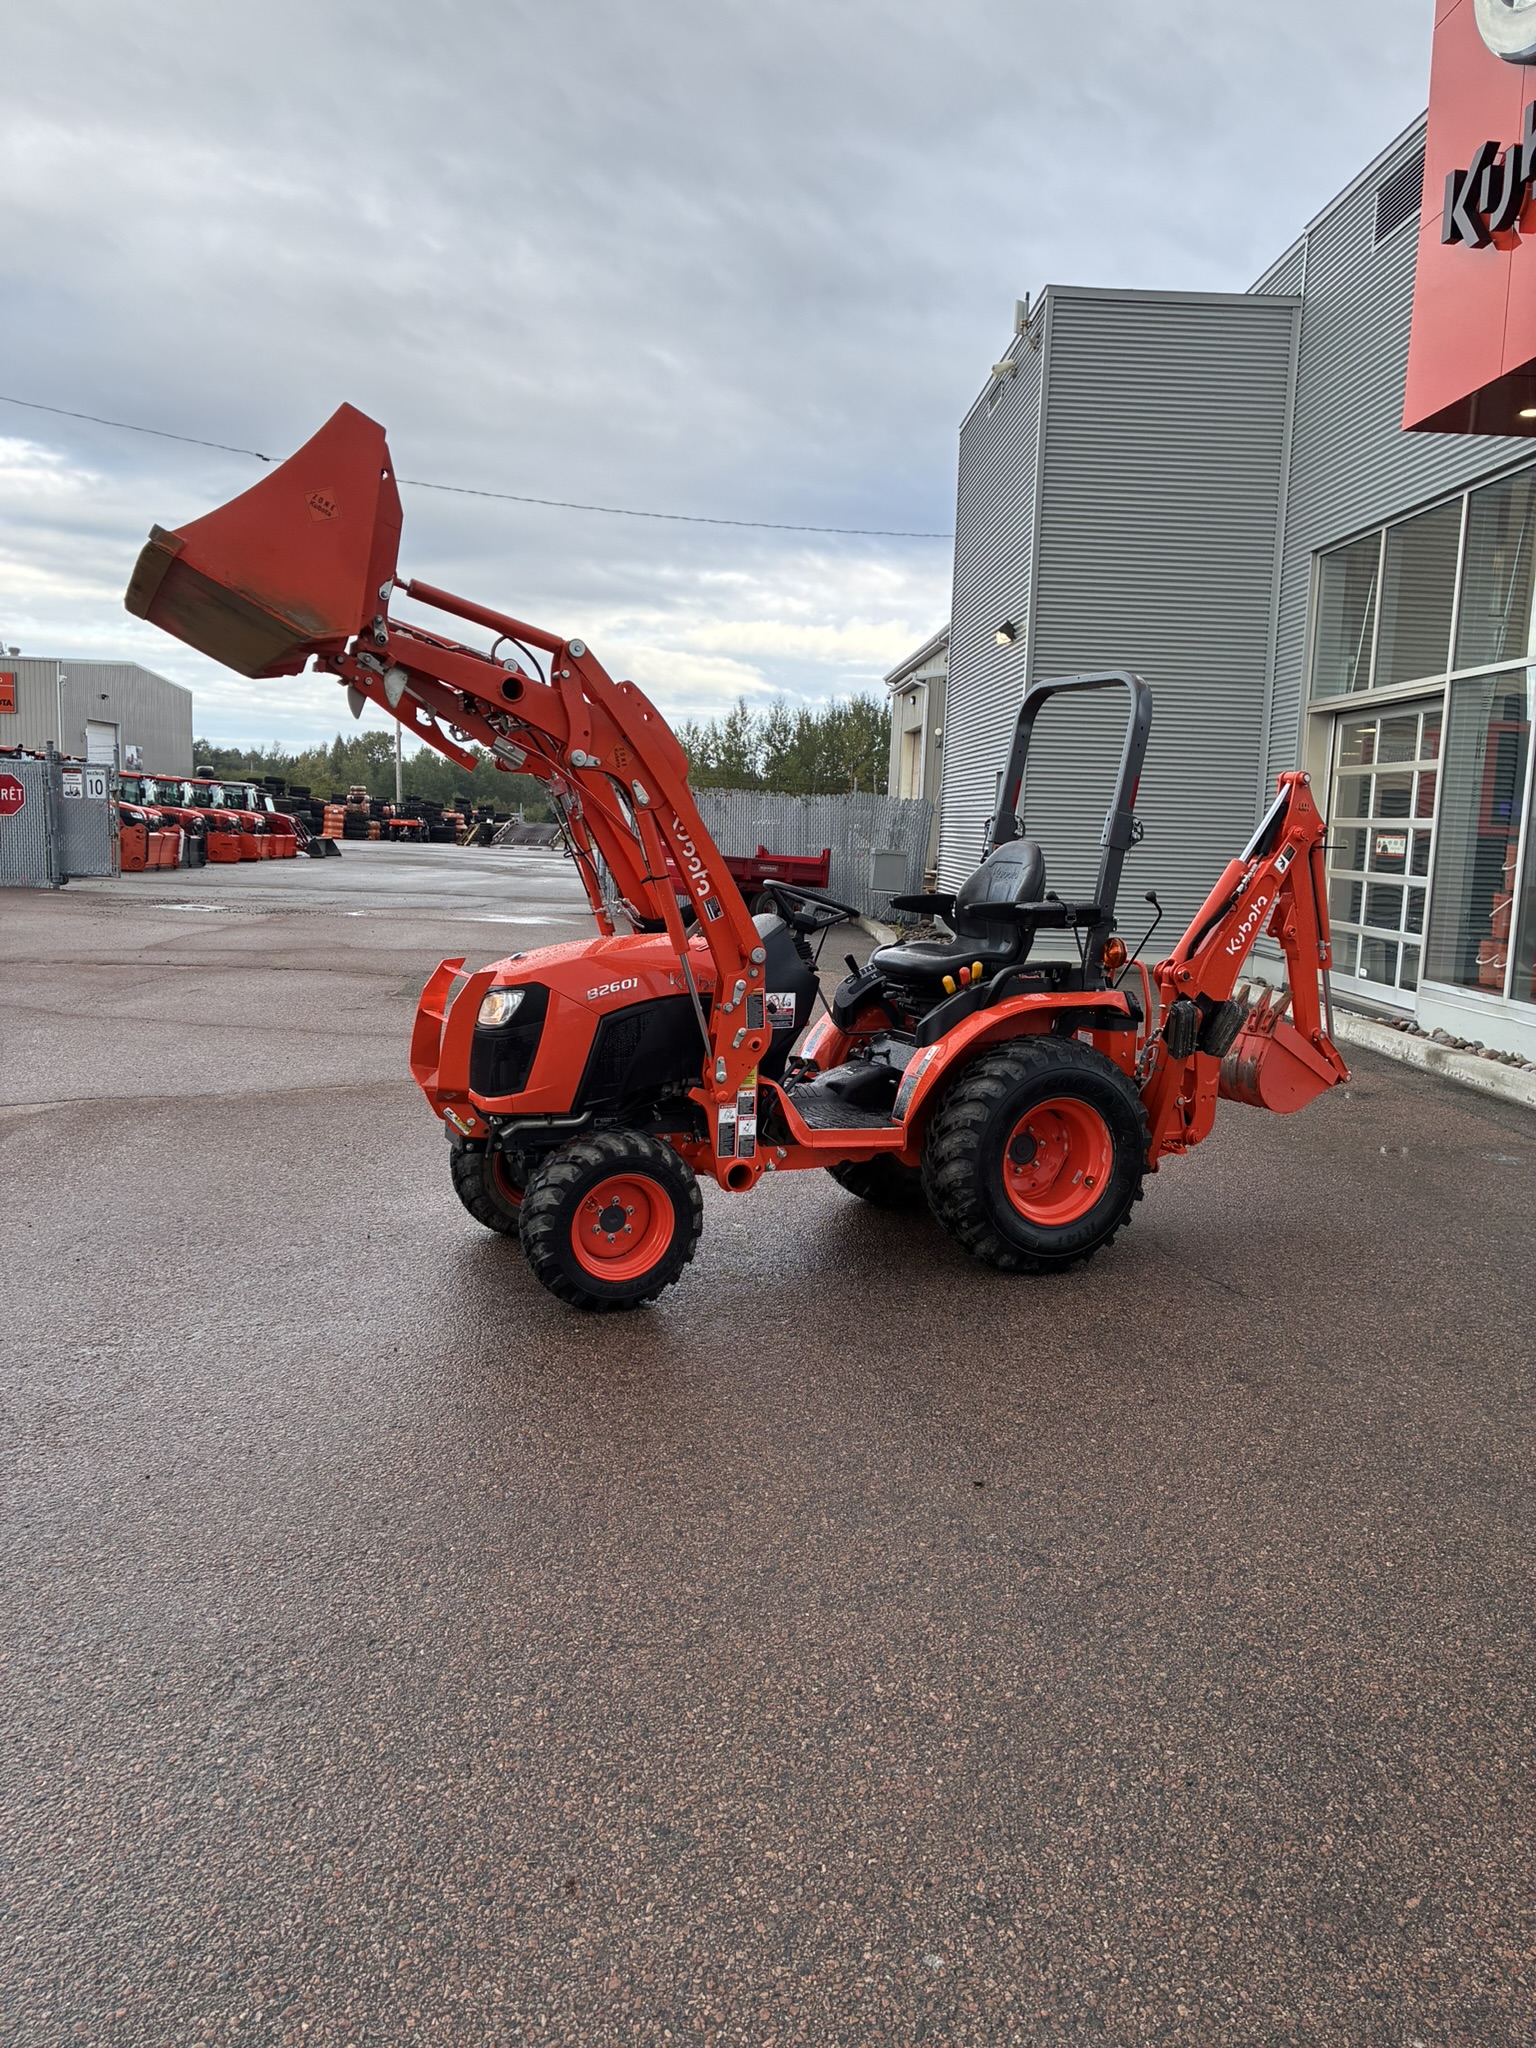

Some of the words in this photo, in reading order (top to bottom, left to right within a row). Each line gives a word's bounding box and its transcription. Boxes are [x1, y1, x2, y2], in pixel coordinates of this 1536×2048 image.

[89, 778, 104, 795] 10
[1225, 895, 1269, 956] Kubota
[586, 977, 638, 1001] B2601
